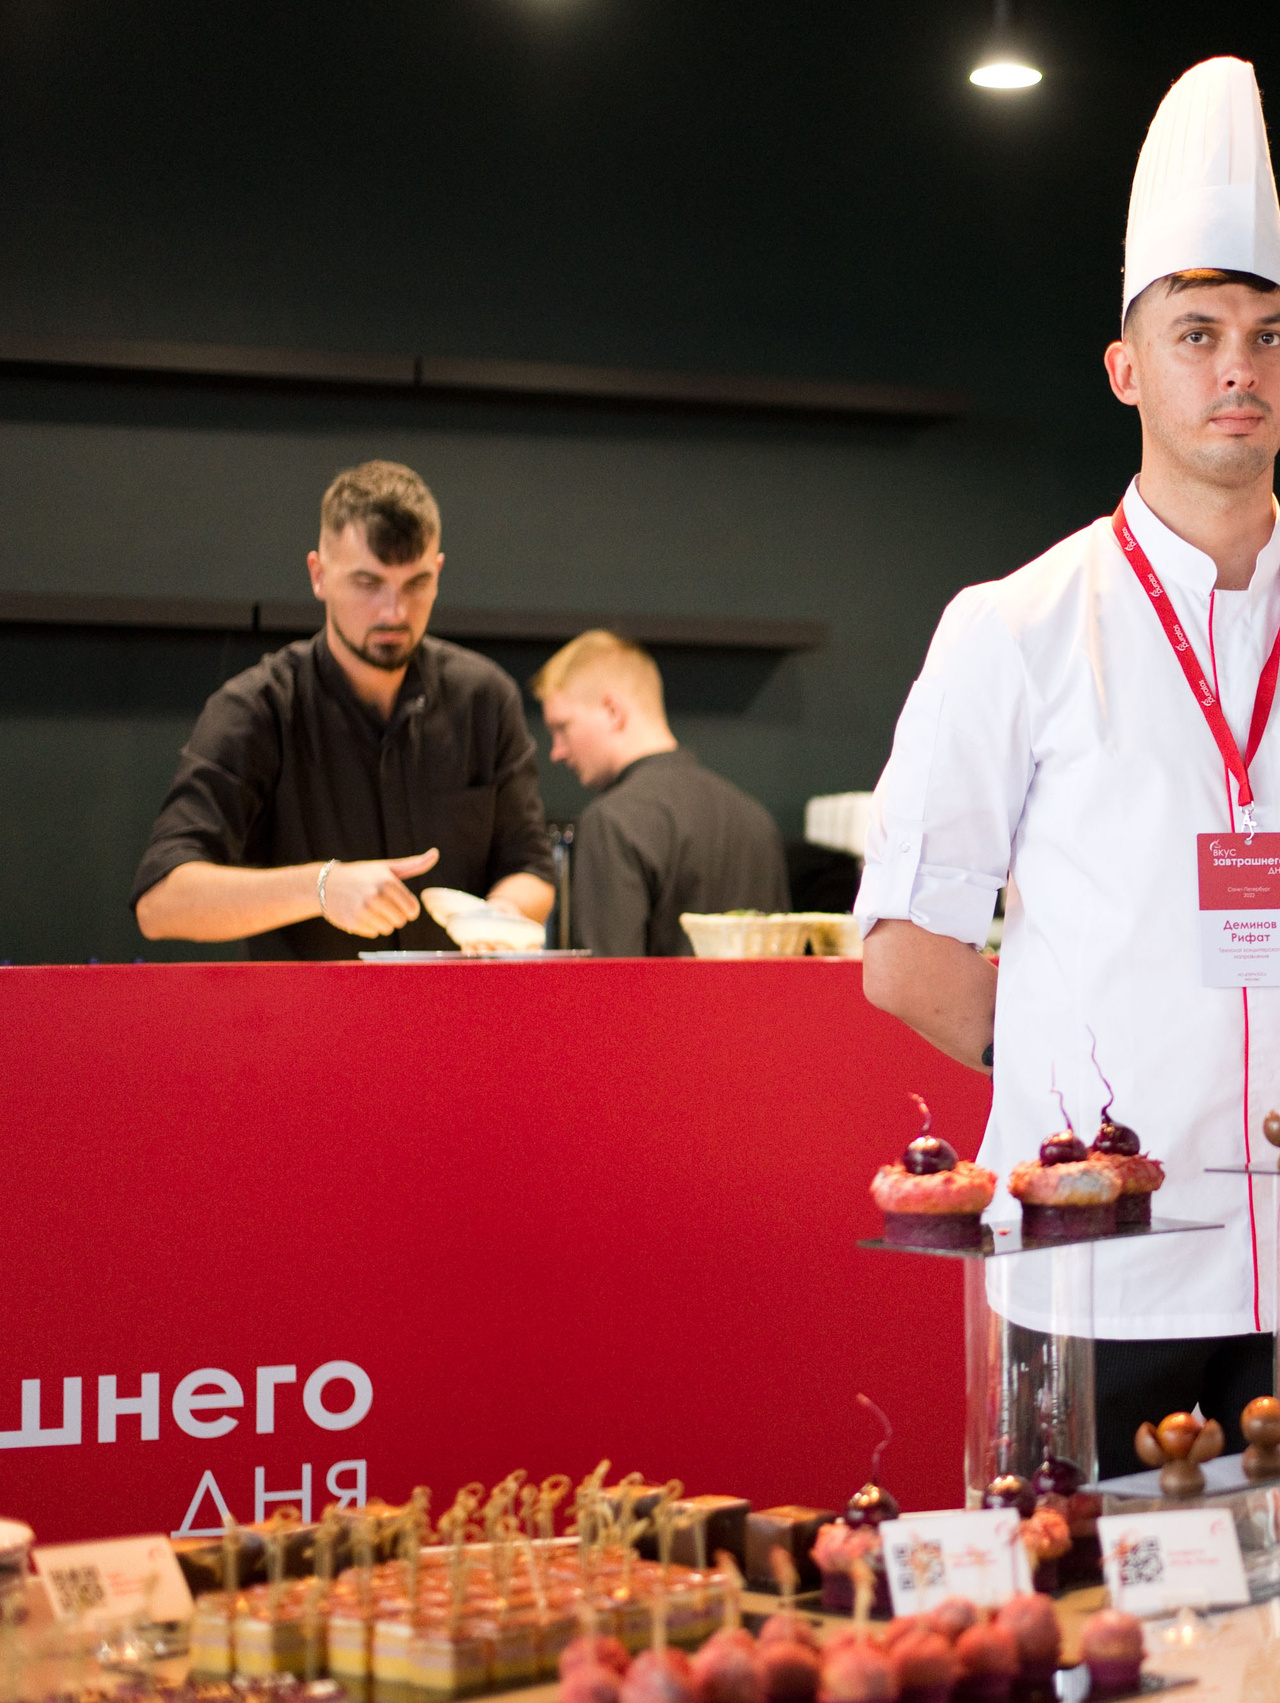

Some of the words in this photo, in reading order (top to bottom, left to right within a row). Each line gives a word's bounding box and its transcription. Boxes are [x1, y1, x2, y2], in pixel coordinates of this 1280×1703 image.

[1213, 848, 1236, 858] вкус
[1223, 920, 1277, 930] Деминов
[1231, 932, 1270, 944] Рифат
